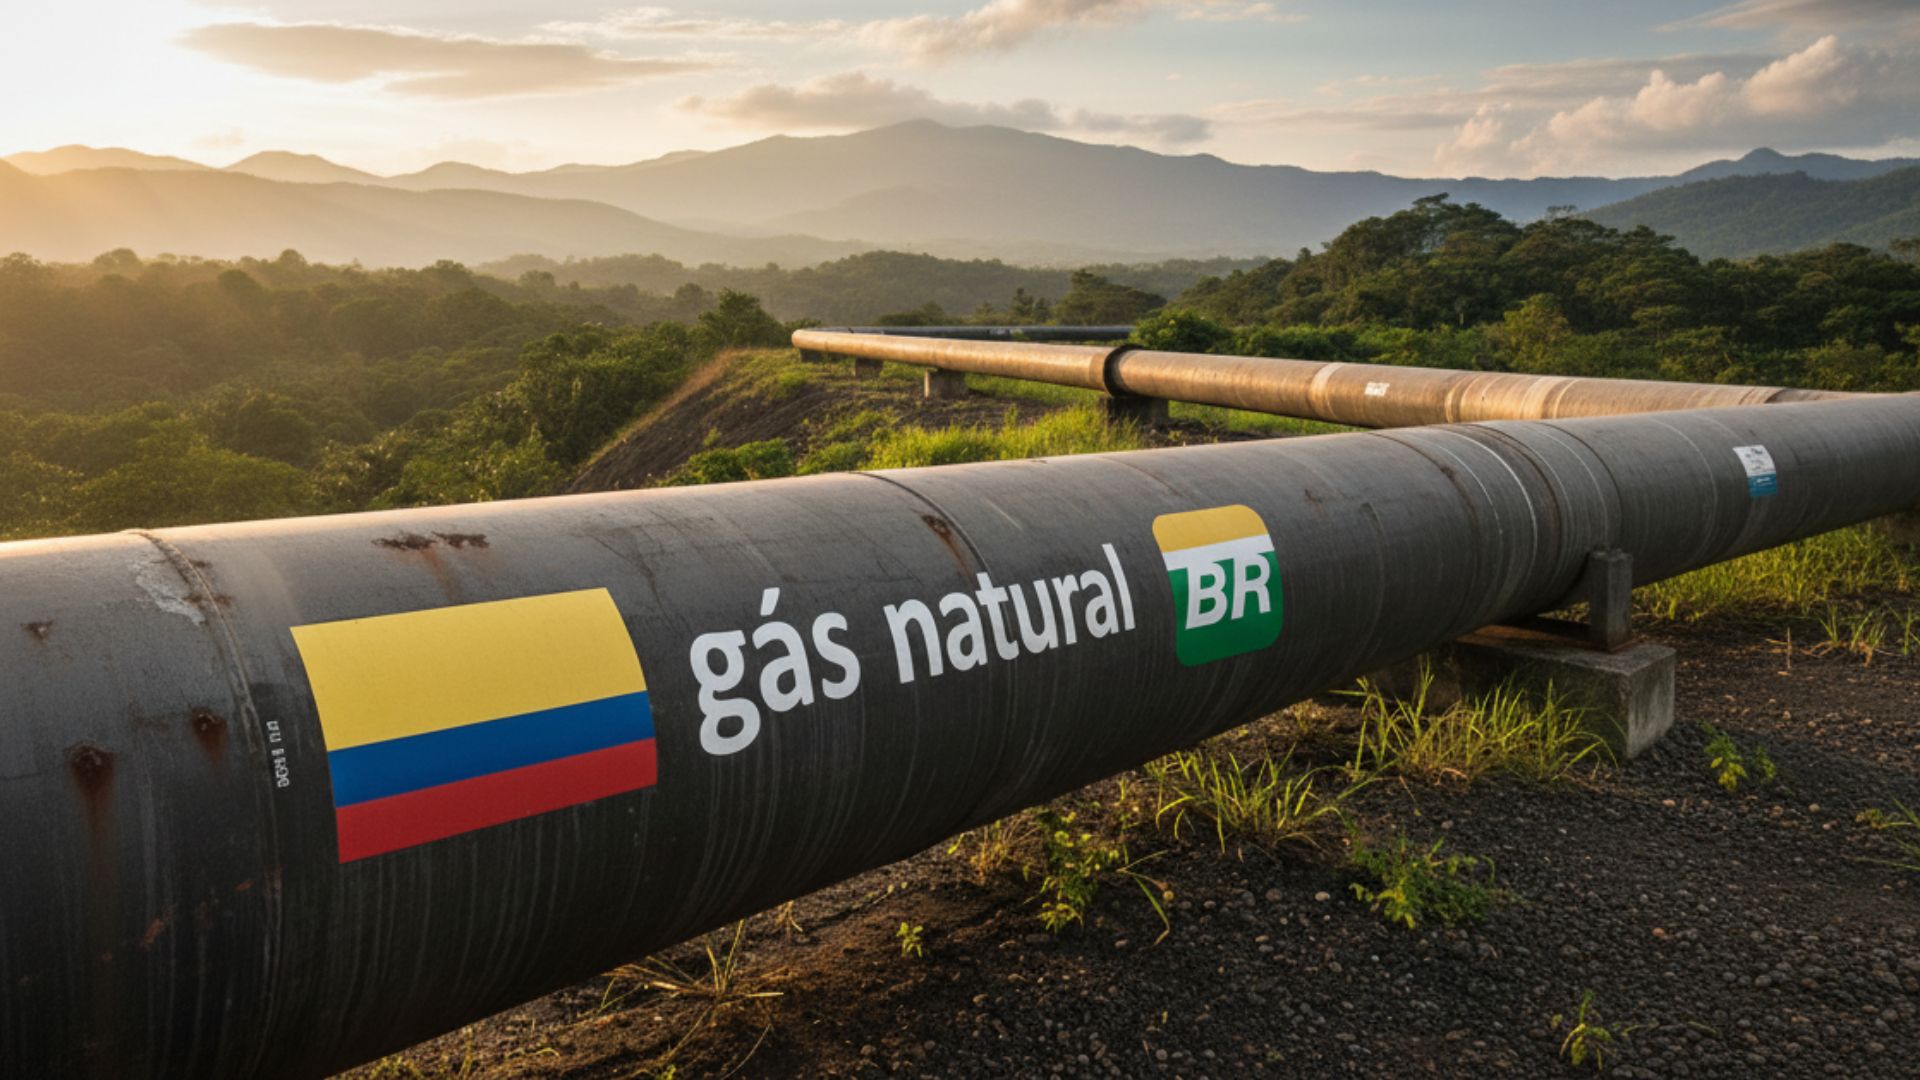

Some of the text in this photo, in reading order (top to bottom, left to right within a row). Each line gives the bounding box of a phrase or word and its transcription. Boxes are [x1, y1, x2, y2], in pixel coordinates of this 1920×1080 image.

[689, 543, 1136, 755] gás natural
[1185, 551, 1272, 630] BR
